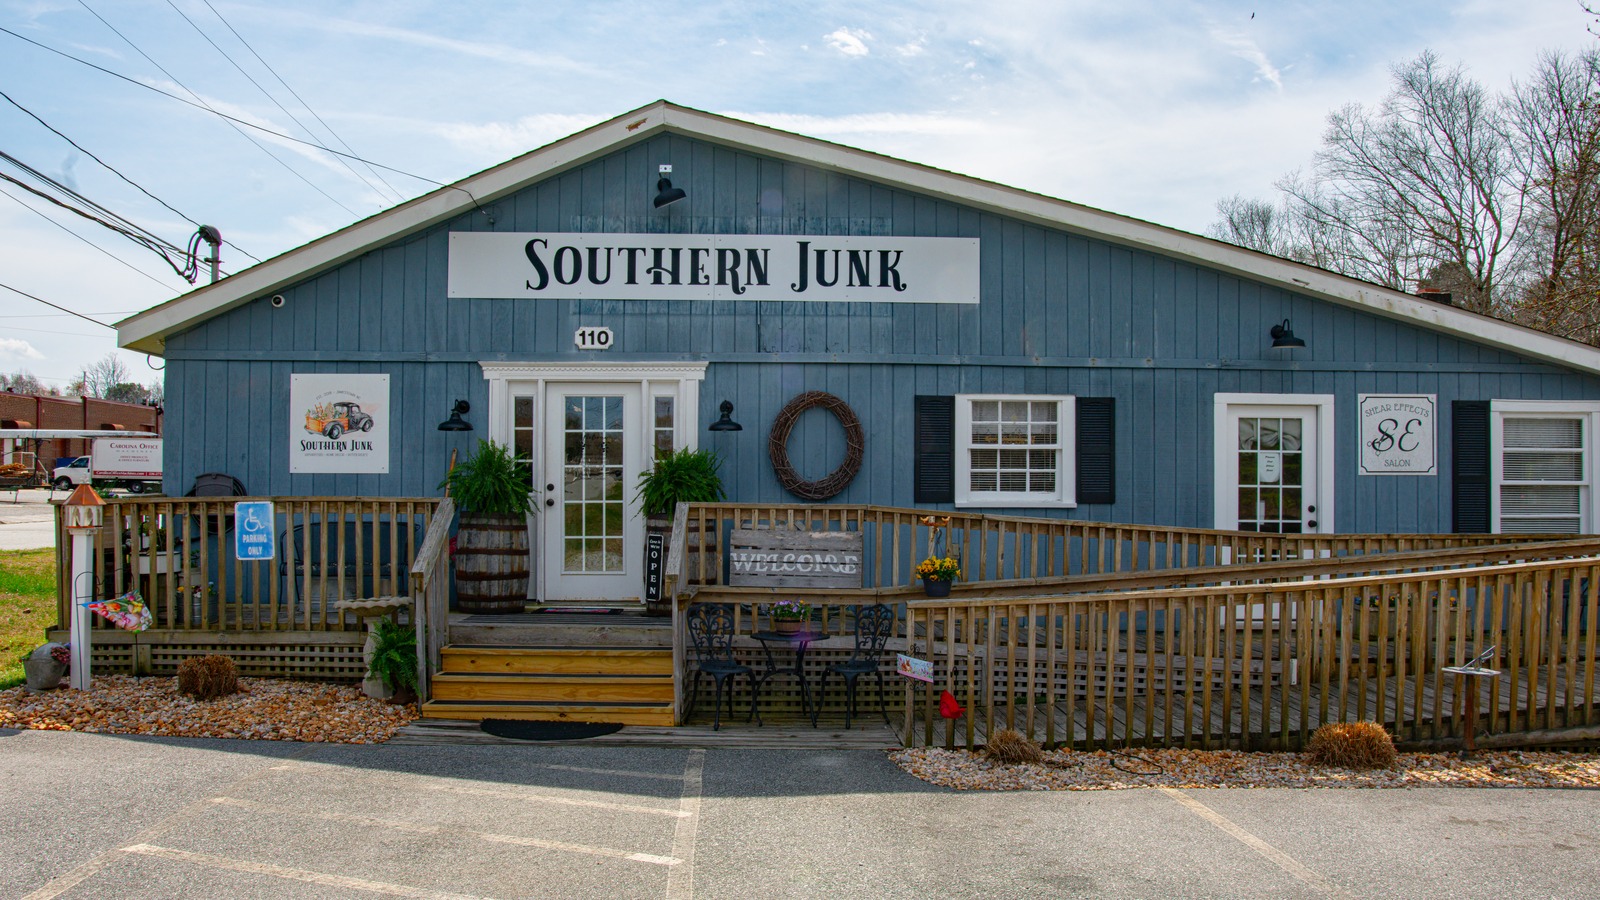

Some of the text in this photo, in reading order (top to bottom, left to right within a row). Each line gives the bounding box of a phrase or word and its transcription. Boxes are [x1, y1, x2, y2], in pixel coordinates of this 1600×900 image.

[524, 238, 908, 295] SOUTHERN JUNK
[579, 330, 609, 345] 110
[1365, 403, 1430, 417] SHEAR EFFECTS
[300, 440, 373, 451] SOUTHERN JUNK
[1384, 459, 1411, 468] SALON
[242, 534, 267, 543] PARKING
[247, 546, 263, 555] ONLY
[730, 552, 858, 574] WELCOME
[650, 550, 658, 594] OPEN
